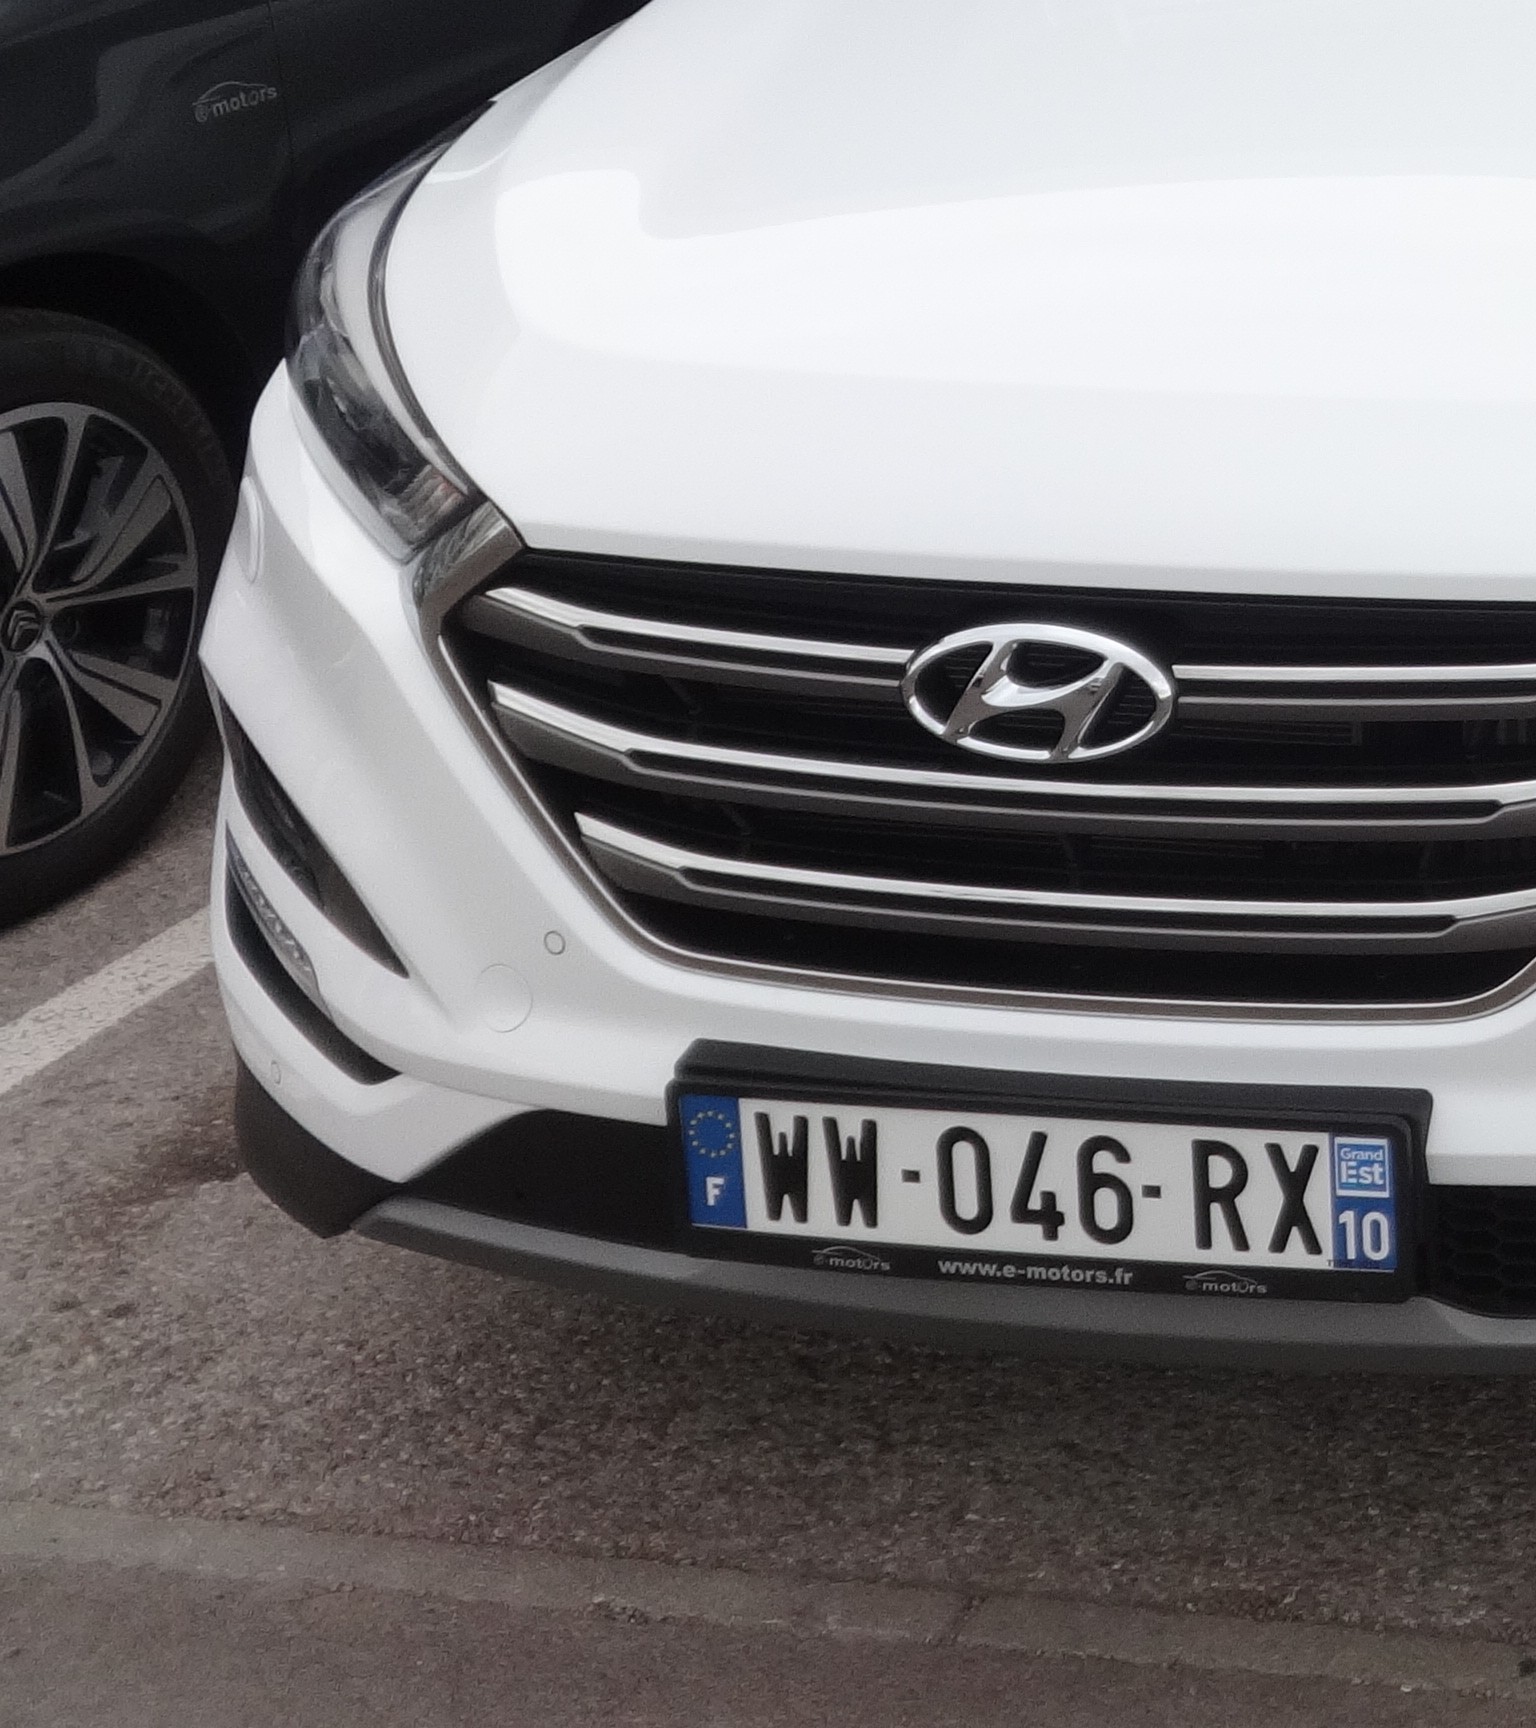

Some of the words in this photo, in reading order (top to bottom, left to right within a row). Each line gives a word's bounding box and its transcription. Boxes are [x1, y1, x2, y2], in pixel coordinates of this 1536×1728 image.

[1340, 1147, 1384, 1161] Grand
[754, 1111, 1323, 1256] WW-046-RX
[1340, 1161, 1385, 1185] Est
[705, 1176, 725, 1208] F
[1338, 1210, 1390, 1261] 10
[938, 1258, 1134, 1286] www.e-motors.fr
